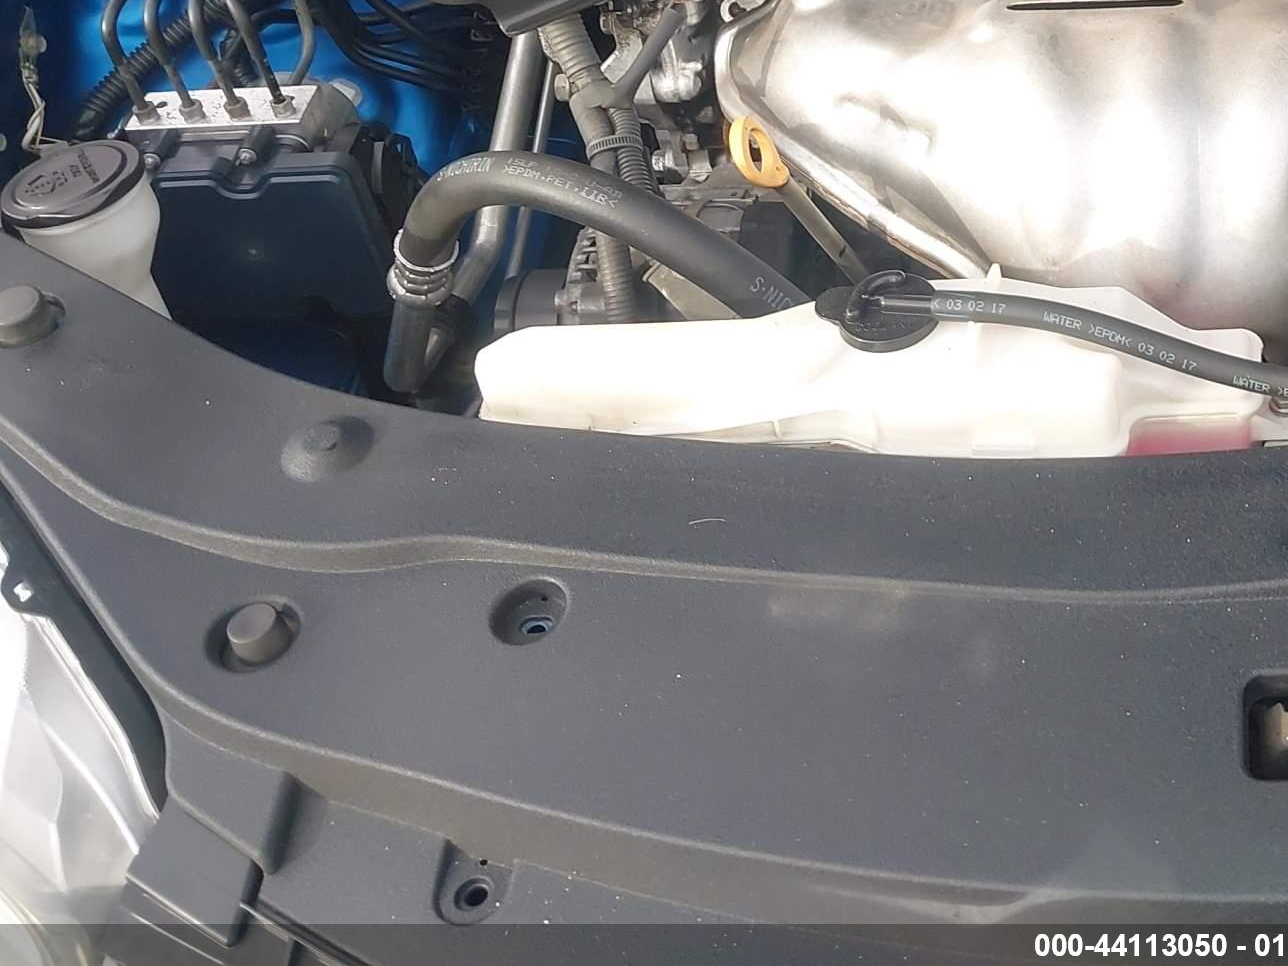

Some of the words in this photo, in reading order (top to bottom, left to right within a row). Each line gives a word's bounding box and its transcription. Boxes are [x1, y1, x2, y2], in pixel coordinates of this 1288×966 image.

[946, 298, 962, 312] 03
[968, 300, 985, 313] 02
[991, 302, 1007, 314] 17
[1042, 311, 1083, 330] WATER
[1137, 341, 1155, 357] 03
[1159, 349, 1177, 365] 02
[1180, 358, 1198, 372] 17
[1232, 374, 1270, 394] WATER
